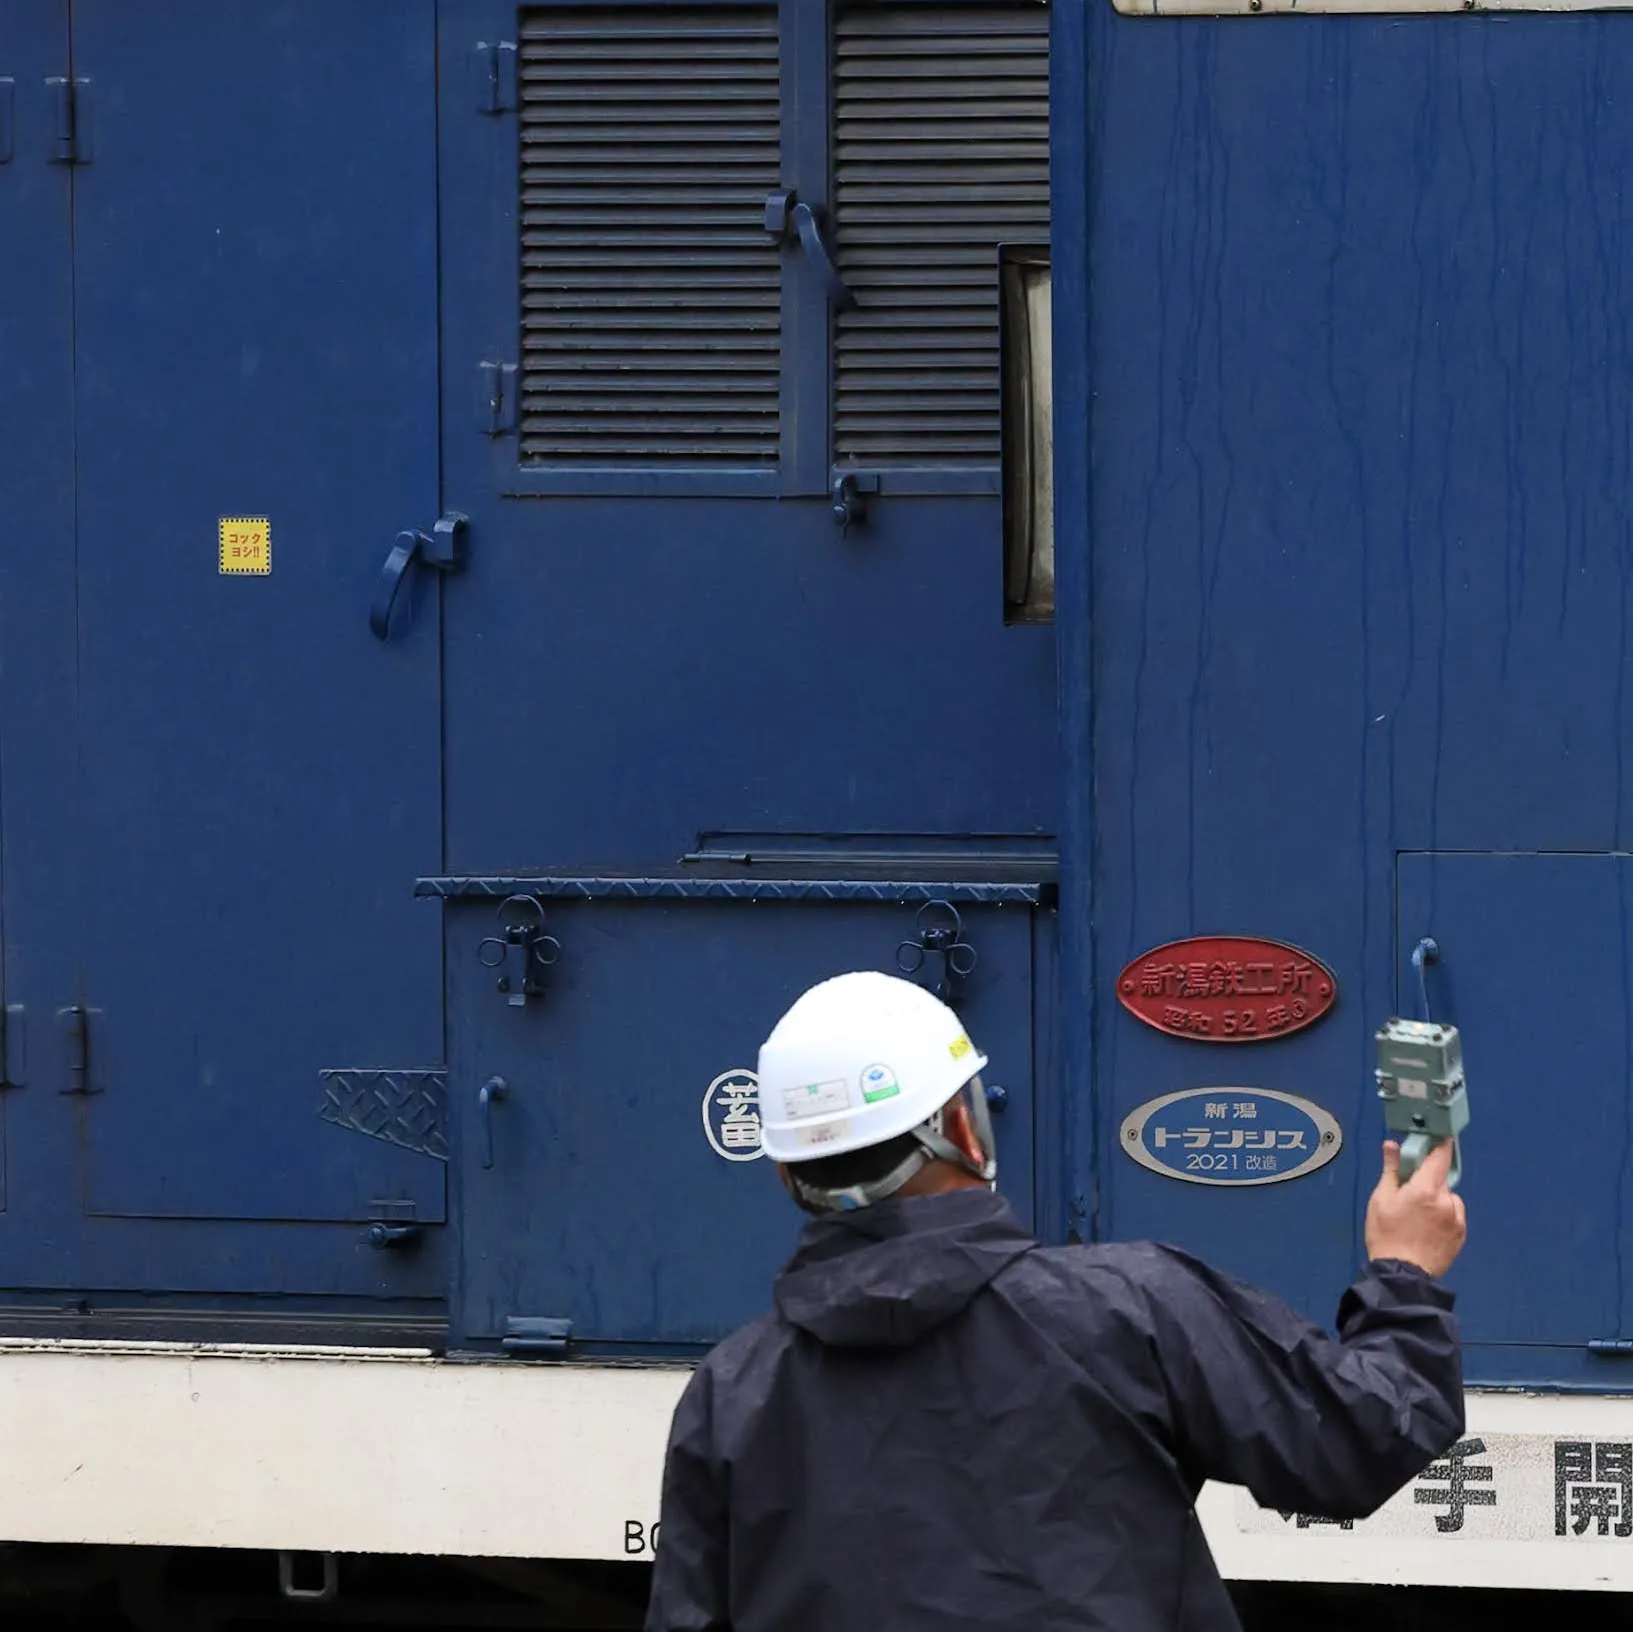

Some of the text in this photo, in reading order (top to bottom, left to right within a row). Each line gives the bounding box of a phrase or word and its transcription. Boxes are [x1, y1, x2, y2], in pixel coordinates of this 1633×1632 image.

[229, 533, 261, 544] コック
[1141, 961, 1312, 998] 新潟鉄工所
[1204, 1102, 1258, 1119] 新潟
[1154, 1127, 1307, 1150] トランシス
